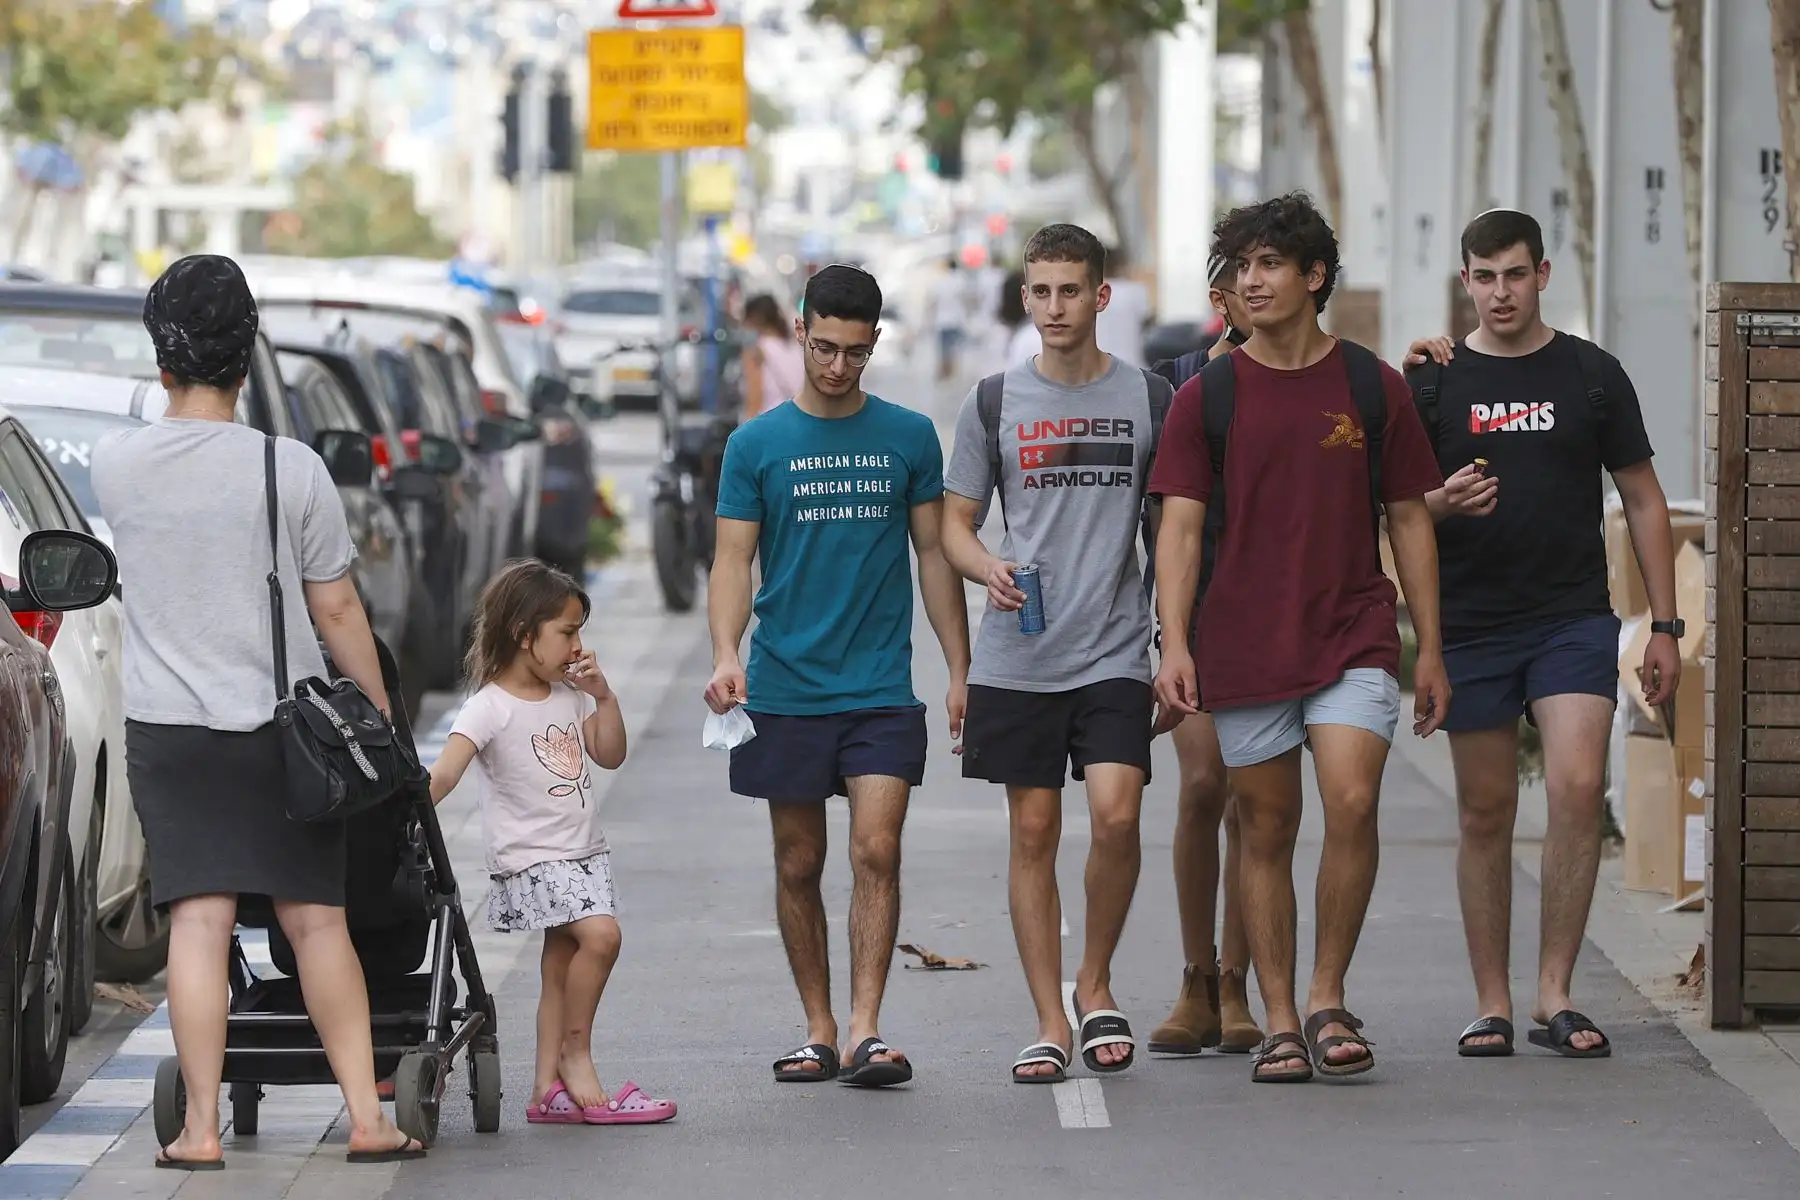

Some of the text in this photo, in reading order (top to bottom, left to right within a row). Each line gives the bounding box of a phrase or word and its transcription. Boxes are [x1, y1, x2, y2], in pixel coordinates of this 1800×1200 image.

[1471, 401, 1555, 433] PARIS
[1017, 418, 1135, 442] UNDER
[789, 455, 890, 472] AMERICAN EAGLE
[793, 480, 891, 497] AMERICAN EAGLE
[1023, 471, 1133, 490] ARMOUR
[797, 505, 890, 522] AMERICAN EAGLE
